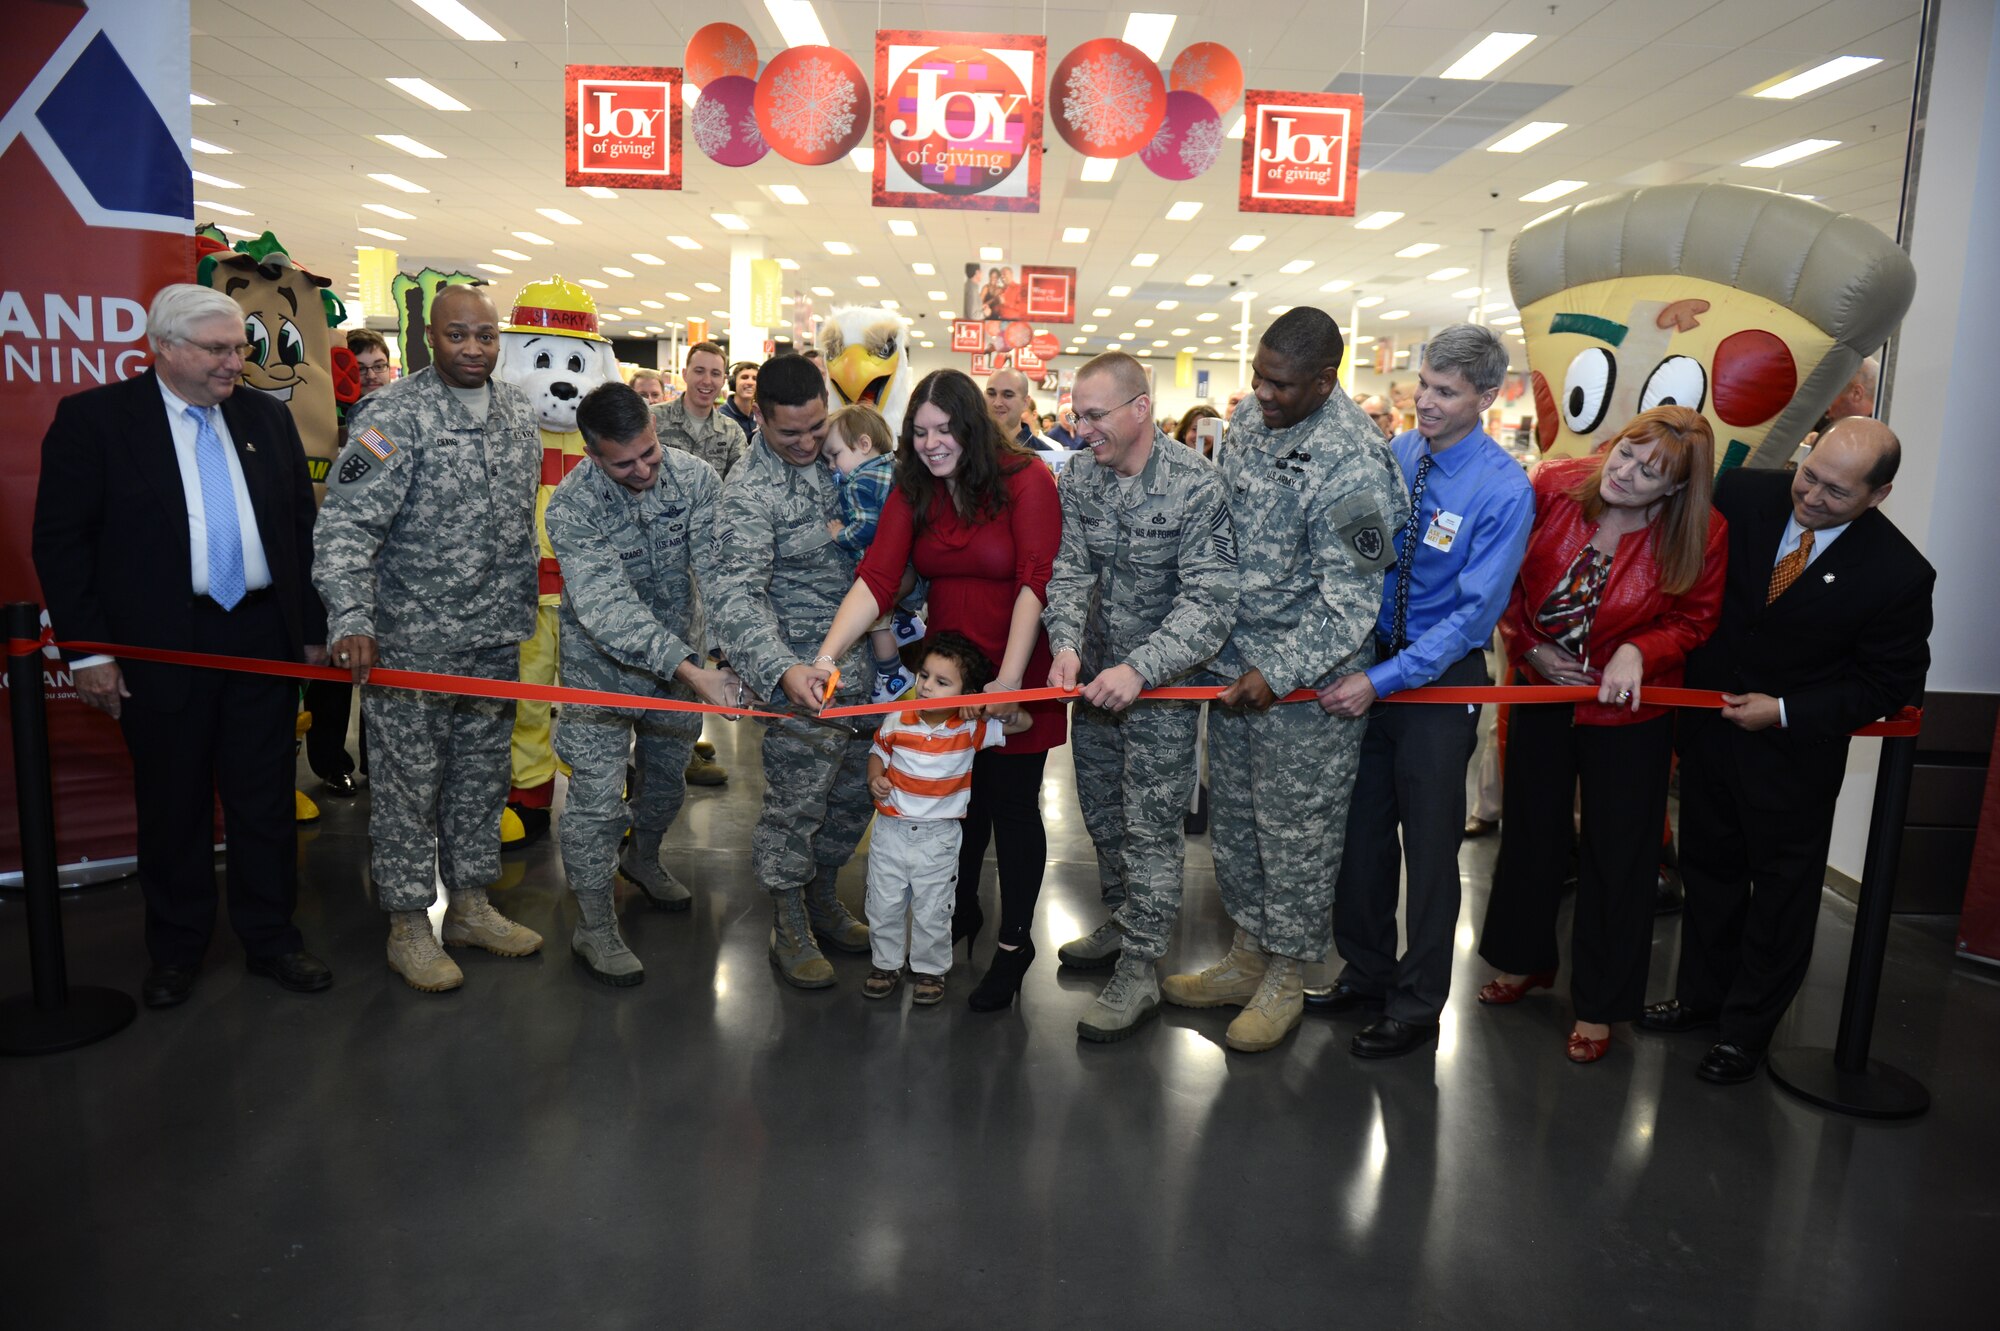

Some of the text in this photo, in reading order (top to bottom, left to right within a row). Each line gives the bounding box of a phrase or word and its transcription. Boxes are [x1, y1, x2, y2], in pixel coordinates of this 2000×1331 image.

[593, 138, 655, 159] of giving!
[906, 143, 1004, 176] of giving
[1267, 164, 1331, 185] of giving!
[1277, 475, 1297, 488] ARMY
[1146, 528, 1157, 538] AIR
[669, 537, 682, 547] AIR
